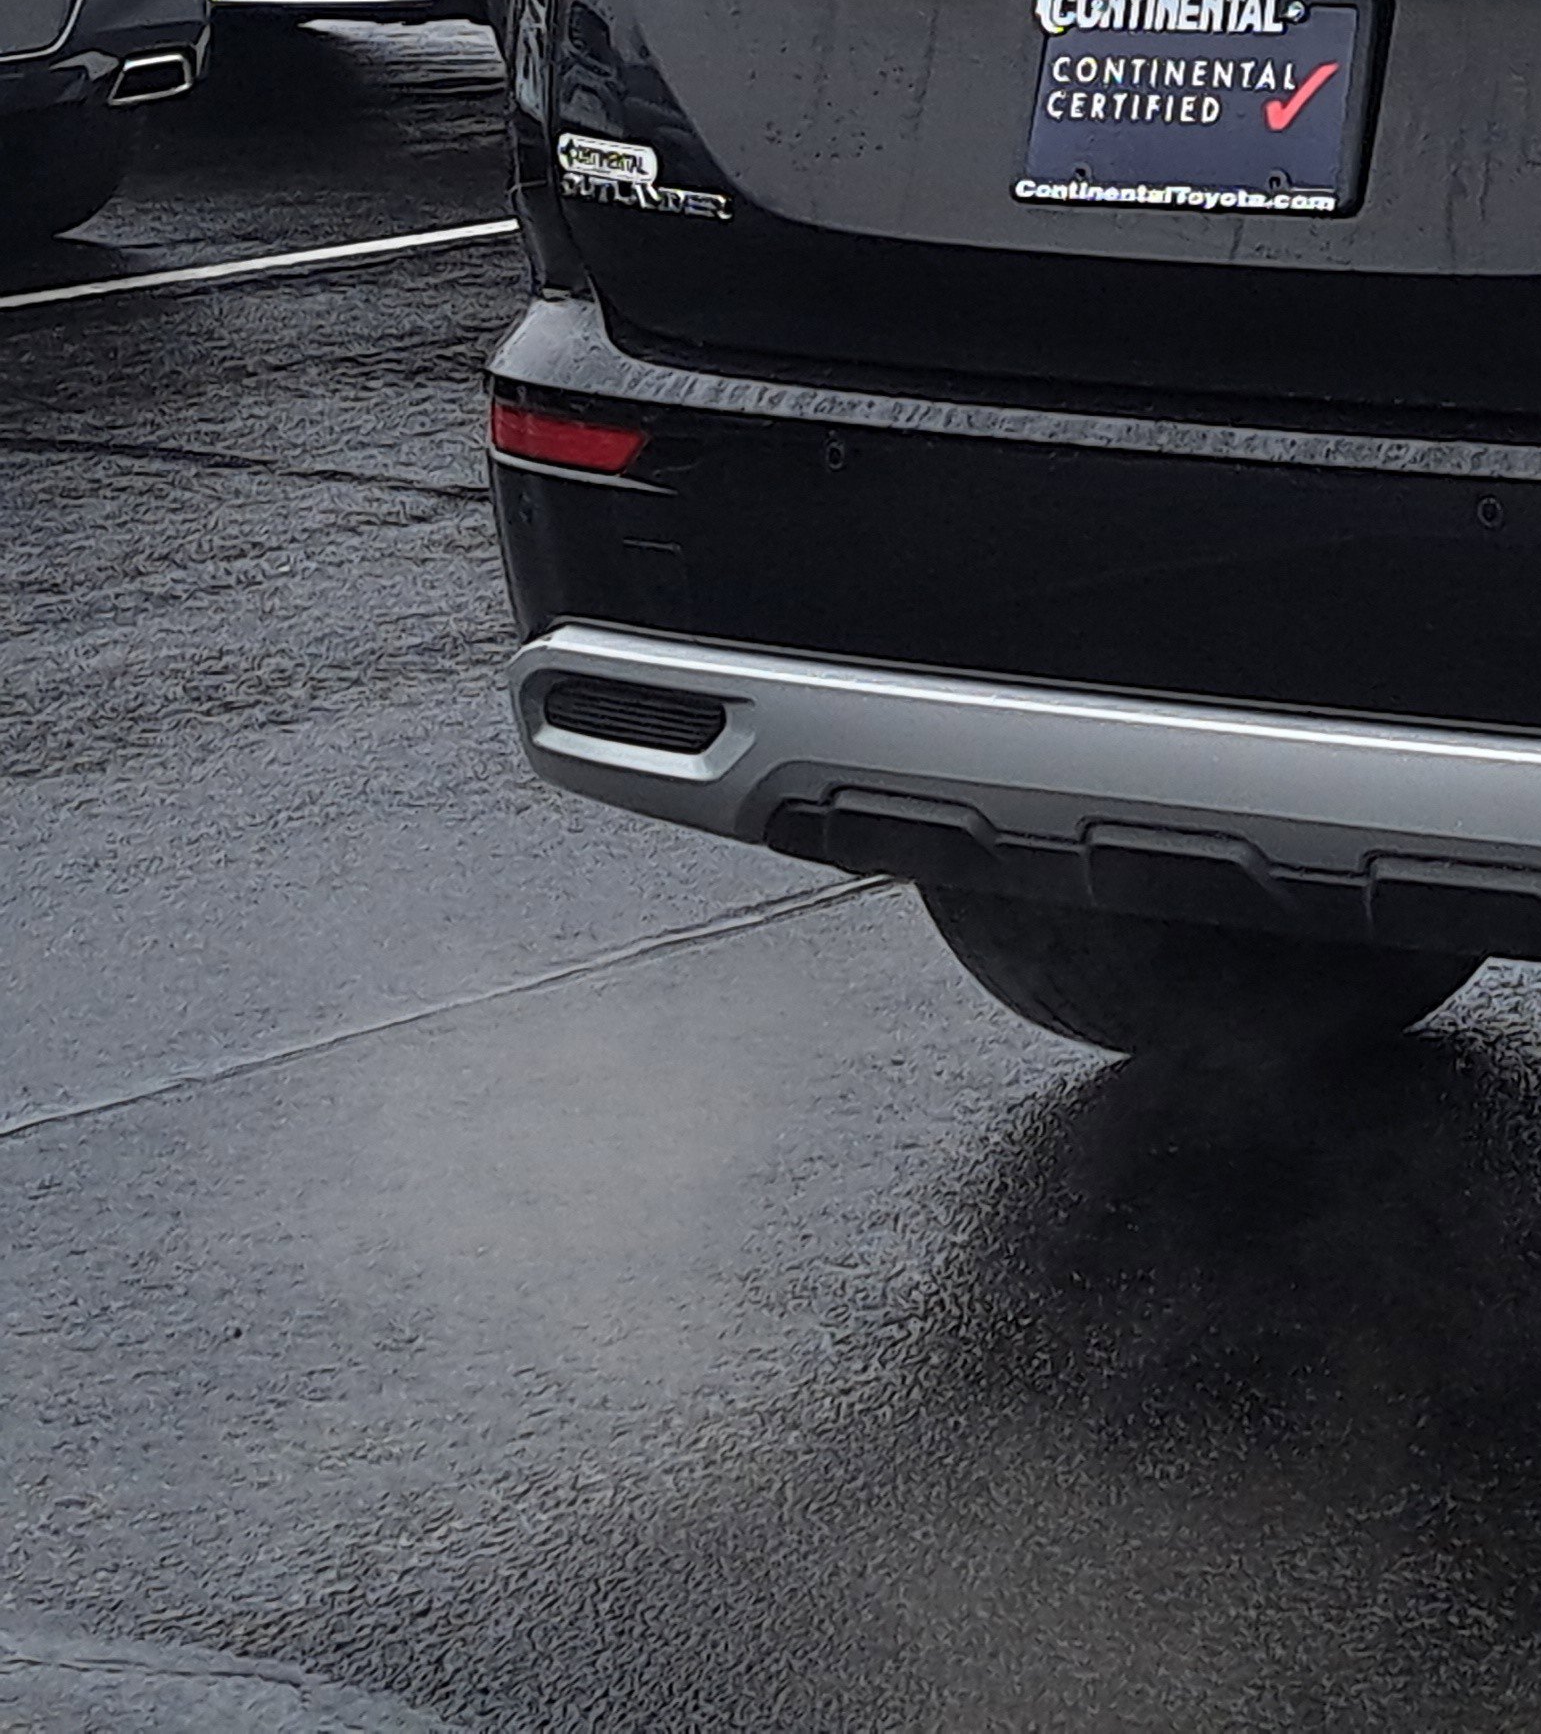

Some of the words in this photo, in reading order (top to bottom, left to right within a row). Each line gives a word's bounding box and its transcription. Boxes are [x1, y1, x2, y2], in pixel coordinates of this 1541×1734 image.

[1051, 55, 1297, 91] CONTINENTAL
[1046, 91, 1222, 124] CERTIFIED
[1014, 178, 1337, 212] ContinentalToyota.com
